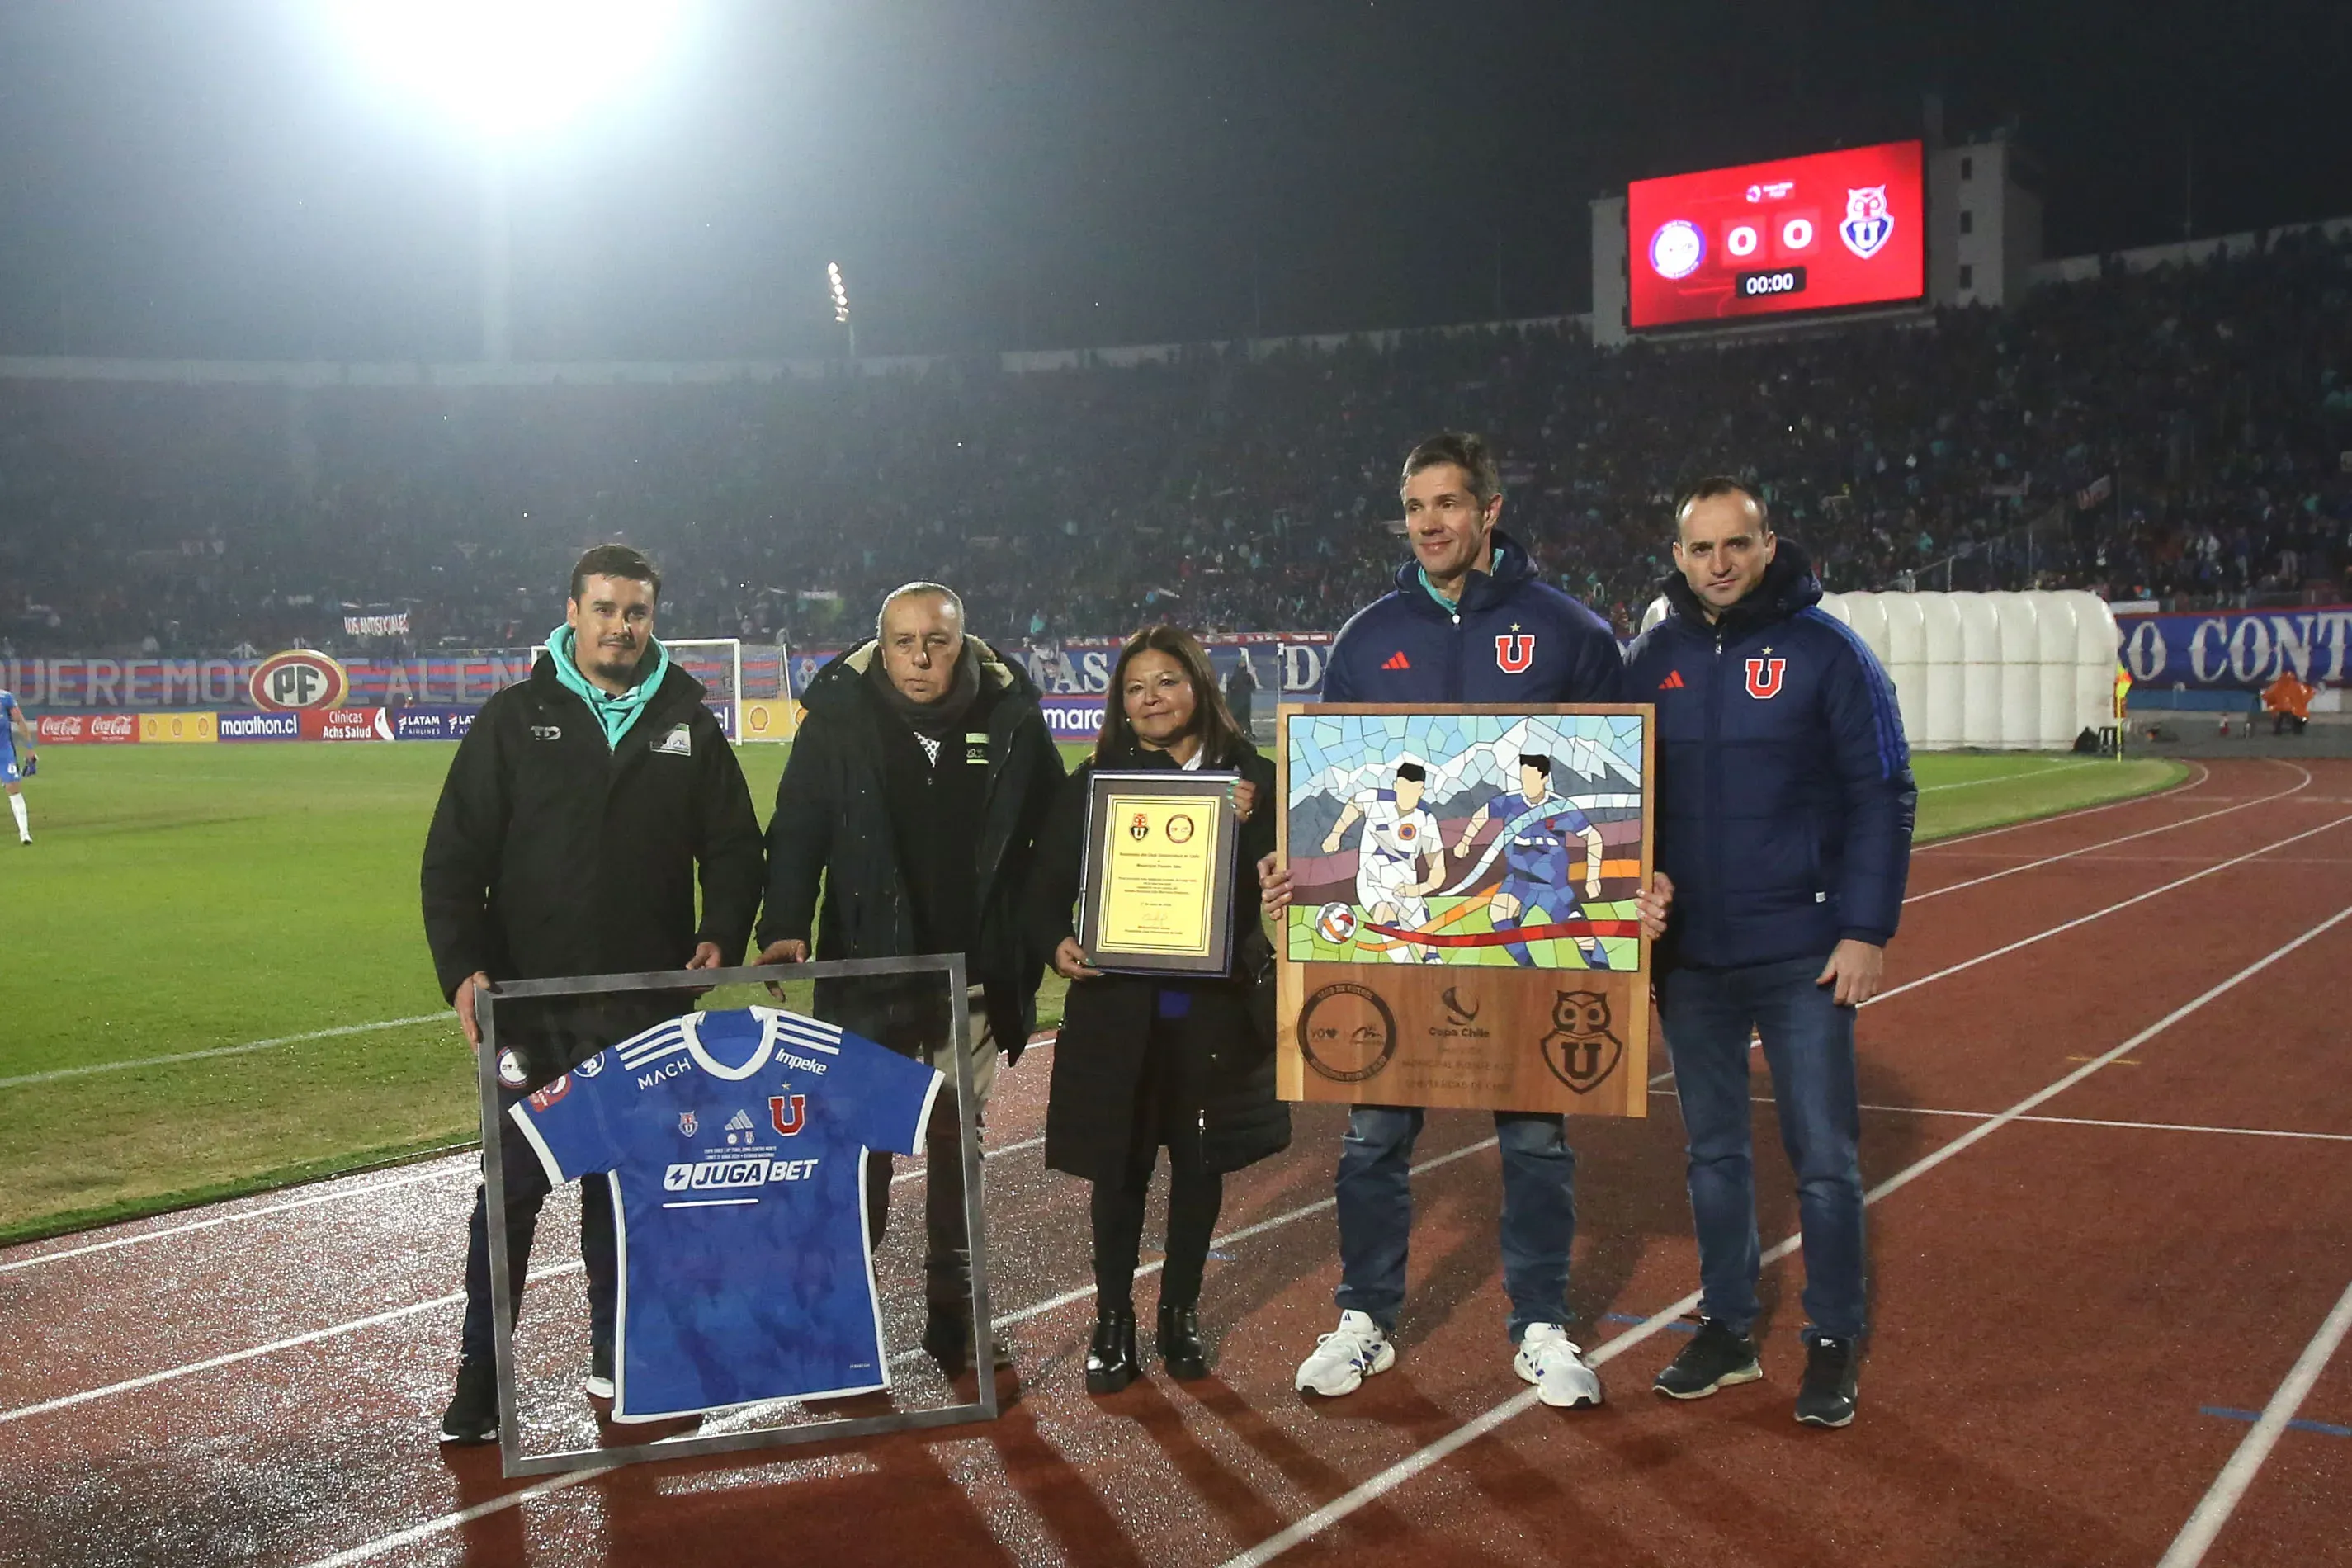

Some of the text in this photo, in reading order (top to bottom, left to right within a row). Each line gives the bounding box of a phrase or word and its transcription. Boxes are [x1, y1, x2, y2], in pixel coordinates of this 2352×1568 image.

[1728, 219, 1813, 256] 0 0
[1746, 273, 1794, 295] 00:00
[1495, 635, 1535, 673] U
[272, 664, 319, 704] PF
[1745, 659, 1786, 699] U
[221, 716, 298, 736] marathon.cl
[323, 725, 371, 739] Achs Salud
[408, 716, 440, 725] LATAM
[1429, 1027, 1490, 1038] Copa Chile
[637, 1057, 692, 1090] MACH
[775, 1048, 827, 1075] Impeke
[1561, 1043, 1602, 1079] U
[768, 1094, 805, 1136] U
